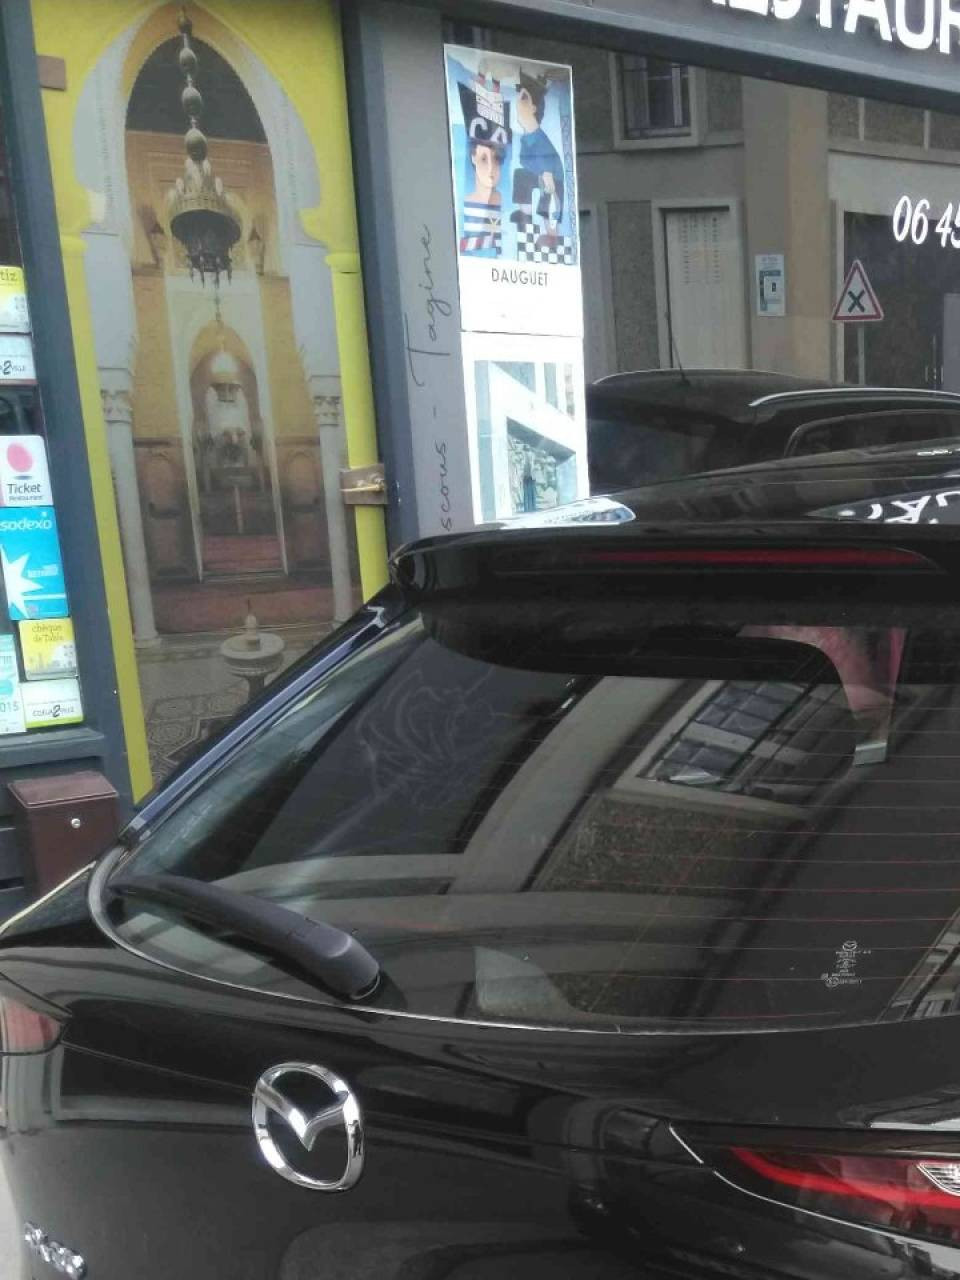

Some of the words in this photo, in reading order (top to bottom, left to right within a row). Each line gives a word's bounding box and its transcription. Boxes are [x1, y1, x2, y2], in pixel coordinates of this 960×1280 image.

[893, 195, 930, 244] 06
[491, 267, 549, 288] DAUGUET
[404, 225, 452, 388] Tagine
[7, 483, 42, 496] Ticket
[0, 518, 52, 532] sodexo
